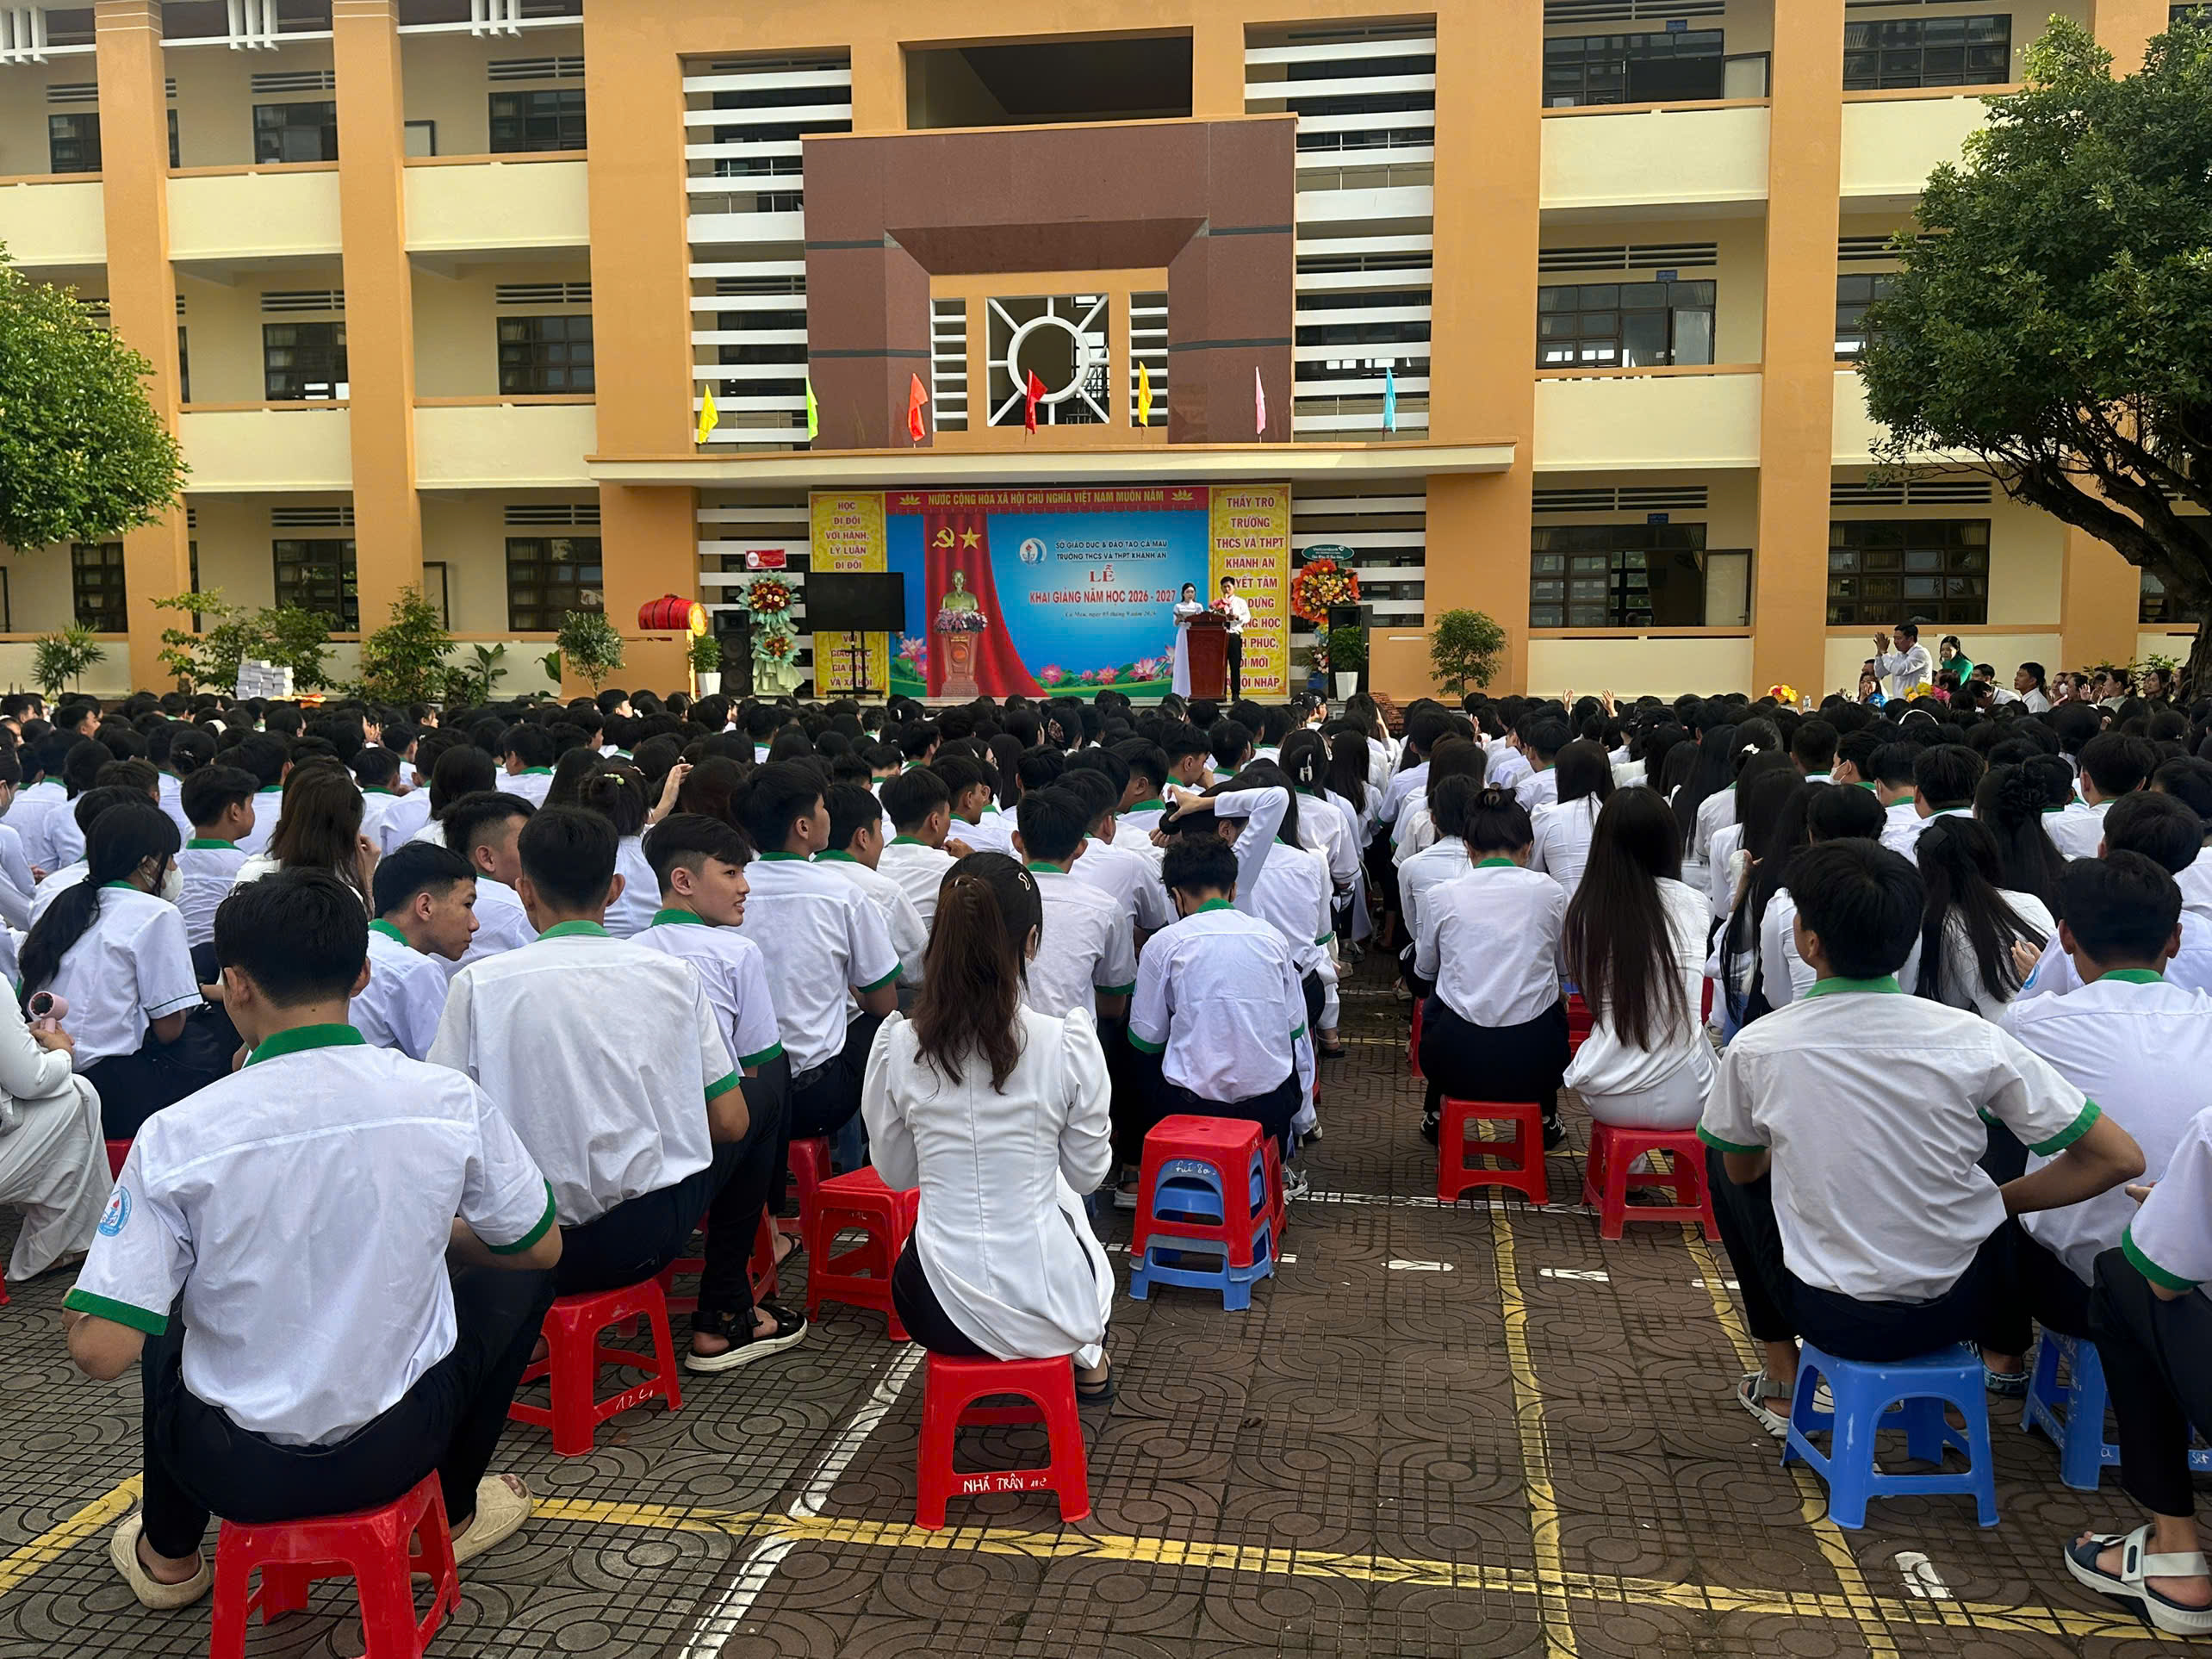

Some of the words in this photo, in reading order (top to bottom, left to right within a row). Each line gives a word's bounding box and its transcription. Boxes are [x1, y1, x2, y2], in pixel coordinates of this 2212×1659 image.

[953, 492, 976, 506] CỘNG
[997, 492, 1009, 504] XÃ
[1010, 491, 1025, 506] HỘI
[1027, 490, 1044, 504] CHỦ
[1046, 490, 1072, 504] NGHĨA
[1074, 490, 1091, 506] VIỆT
[1094, 492, 1114, 502] NAM
[1116, 490, 1141, 501] MUÔN
[1144, 489, 1164, 501] NĂM
[837, 502, 855, 511] HỌC
[846, 515, 861, 525] ĐÔI
[1231, 515, 1271, 528] TRƯỜNG
[1216, 538, 1241, 548] THCS
[1244, 536, 1256, 548] VÀ
[1259, 537, 1284, 548] THPT
[830, 545, 841, 554] LÝ
[843, 545, 867, 556] LUẬN
[847, 560, 862, 569] ĐÔI
[1226, 556, 1258, 569] KHÁNH
[1262, 558, 1275, 568] AN
[1090, 564, 1115, 582] LỄ
[1235, 574, 1253, 588] YẾT
[1257, 575, 1277, 587] TÂM
[1030, 591, 1050, 603] KHAI
[1053, 587, 1081, 603] GIẢNG
[1084, 588, 1103, 602] NĂM
[1106, 590, 1126, 606] HỌC
[1128, 590, 1148, 602] 2026
[1156, 590, 1177, 602] 2027
[1248, 597, 1274, 611] DỰNG
[1261, 618, 1281, 630] HỌC
[1251, 656, 1268, 668] MỚI
[1254, 675, 1280, 689] NHẬP
[996, 1472, 1023, 1490] TRÂN
